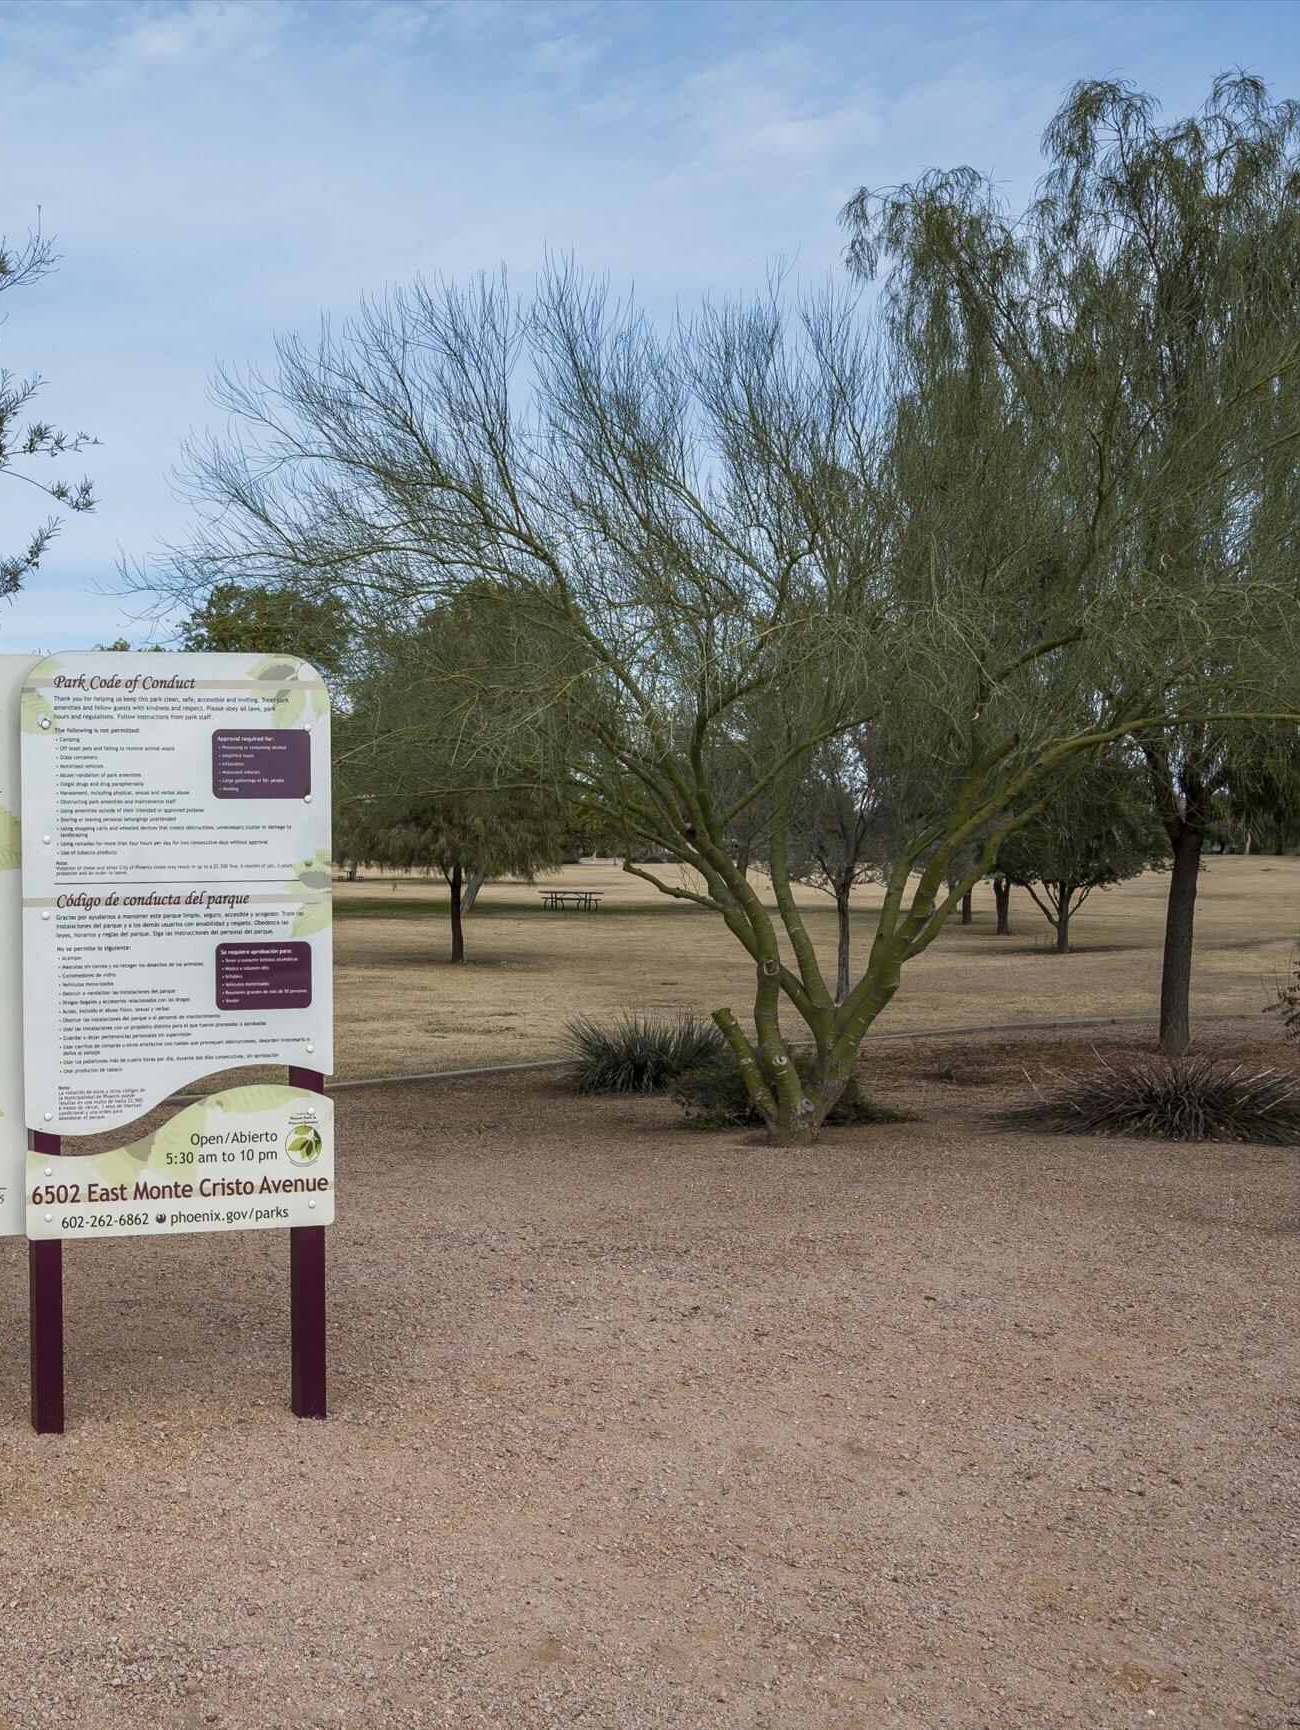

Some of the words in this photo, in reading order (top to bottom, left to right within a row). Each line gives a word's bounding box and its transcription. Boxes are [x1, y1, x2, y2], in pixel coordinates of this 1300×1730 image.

[53, 674, 89, 691] Park
[90, 674, 120, 690] Code
[125, 674, 141, 693] of
[142, 674, 196, 690] Conduct
[93, 695, 114, 703] helping
[122, 695, 137, 703] keep
[149, 695, 162, 703] park
[263, 705, 276, 713] park
[66, 727, 92, 735] following
[56, 892, 101, 911] Código
[104, 891, 119, 907] de
[123, 891, 181, 906] conducta
[185, 890, 206, 905] del
[206, 894, 250, 909] parque
[88, 913, 116, 921] ayudarnos
[72, 945, 96, 953] permite
[190, 1131, 278, 1147] Open/Abierto
[166, 1152, 194, 1165] 5:30
[198, 1154, 217, 1163] am
[222, 1152, 235, 1163] to
[239, 1149, 254, 1161] 10
[259, 1151, 278, 1163] pm
[32, 1184, 81, 1205] 6502
[87, 1182, 127, 1202] East
[133, 1181, 193, 1200] Monte
[200, 1178, 254, 1197] Cristo
[259, 1176, 328, 1194] Avenue
[61, 1213, 149, 1229] 602-262-6862
[171, 1206, 289, 1226] phoenix.gov/parks
